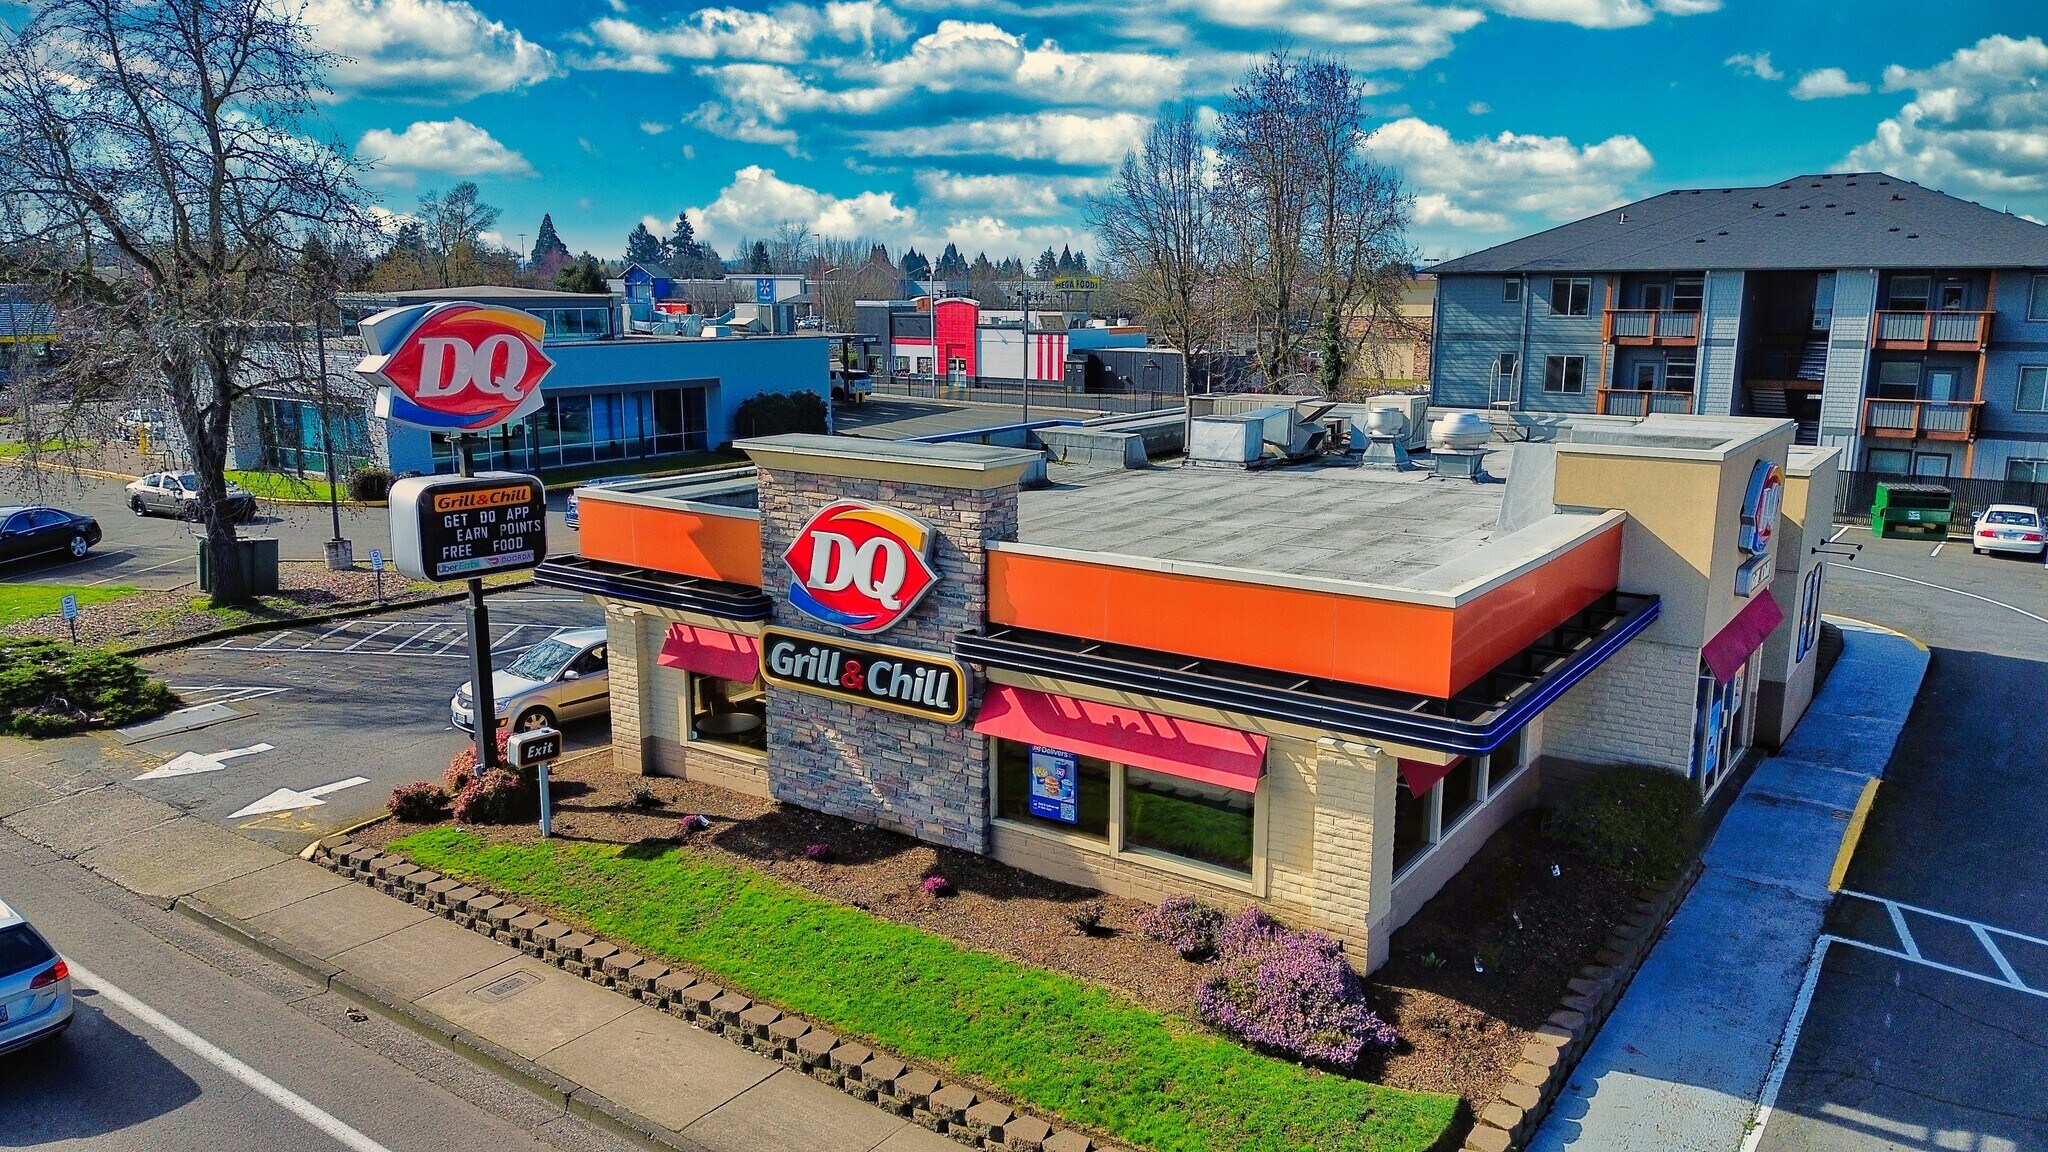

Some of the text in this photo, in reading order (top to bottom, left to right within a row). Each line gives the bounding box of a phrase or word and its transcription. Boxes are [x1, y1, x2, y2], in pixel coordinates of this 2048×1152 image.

[415, 334, 529, 402] DQ
[444, 506, 530, 528] GET DQ APP
[457, 519, 541, 542] EARN POINTS
[442, 536, 523, 560] FREE FOOD
[437, 563, 458, 573] Uber
[460, 560, 480, 570] Eats
[806, 530, 907, 611] DQ
[527, 741, 554, 759] Exit
[1041, 746, 1068, 758] Delivers
